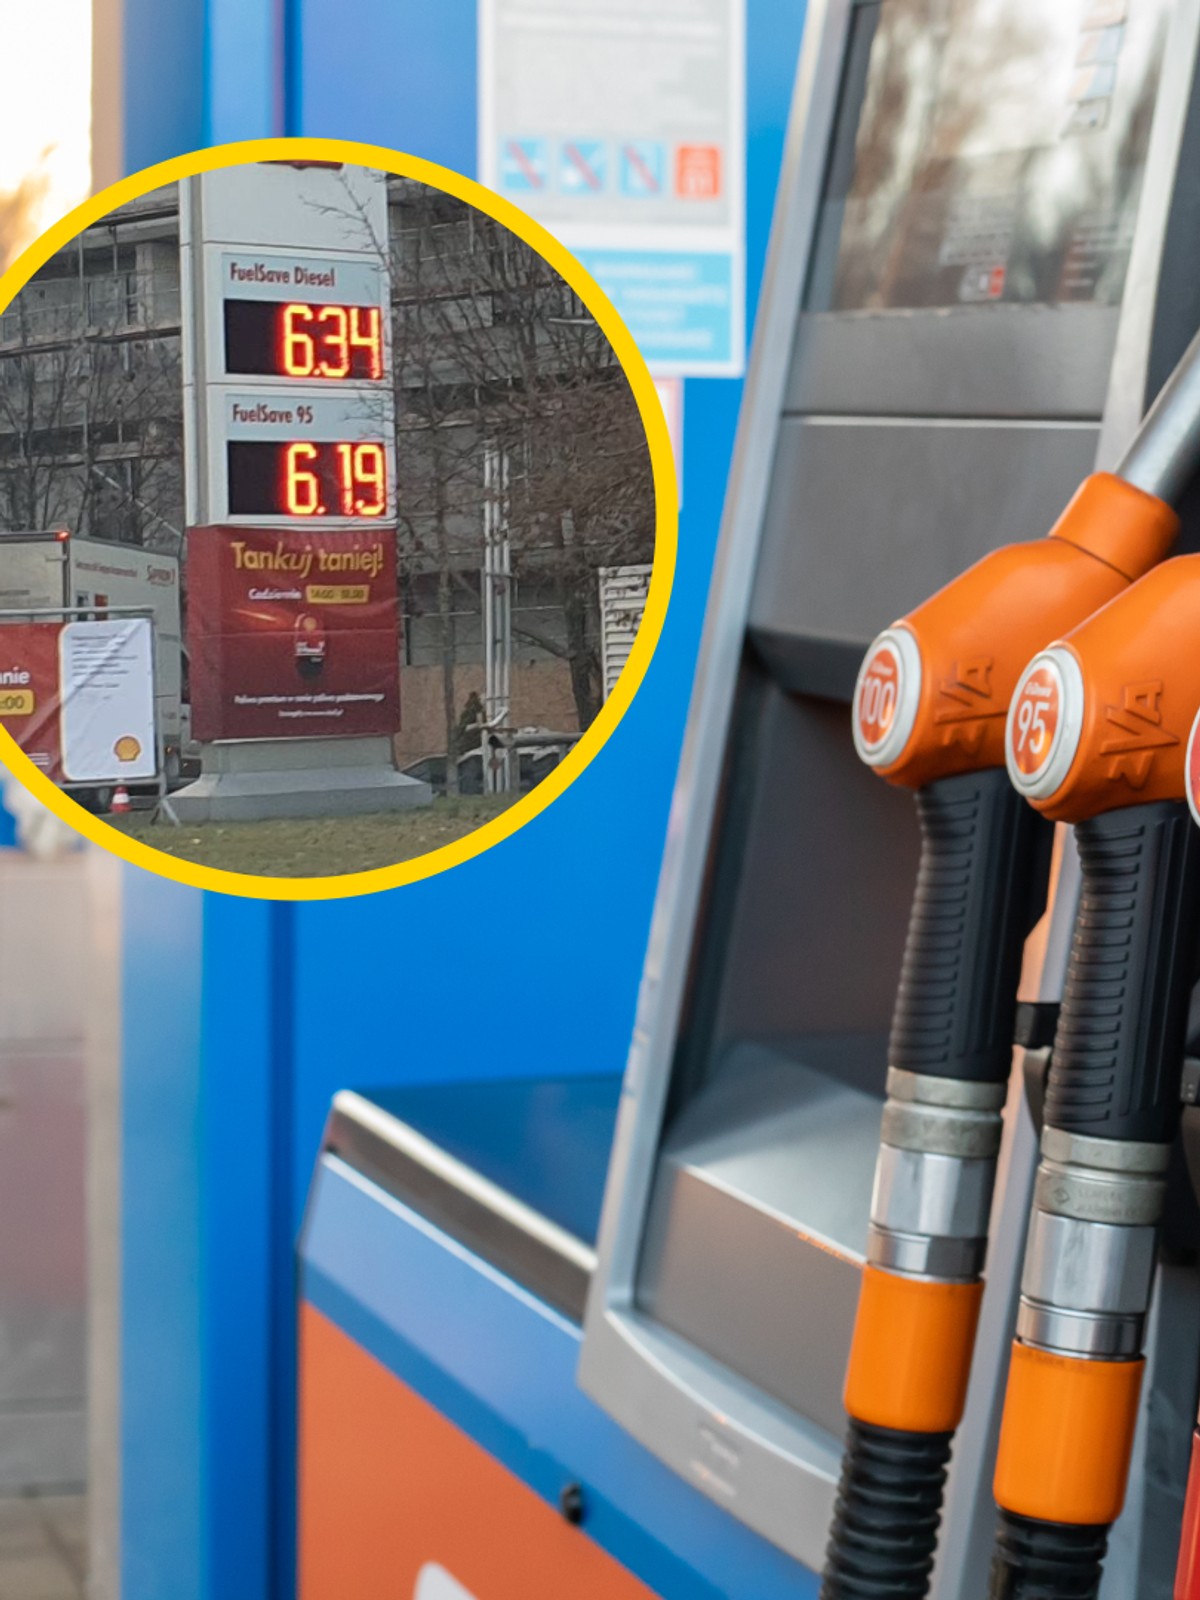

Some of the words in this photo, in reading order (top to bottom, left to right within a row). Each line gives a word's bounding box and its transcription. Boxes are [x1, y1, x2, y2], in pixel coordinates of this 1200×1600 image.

[230, 262, 290, 284] FuelSave
[294, 266, 336, 287] Diesel
[283, 303, 382, 379] 6.34
[232, 403, 294, 424] FuelSave
[296, 405, 314, 424] 95
[286, 442, 385, 516] 6.19
[229, 541, 314, 579] Tankuj
[317, 542, 384, 578] taniej!
[0, 665, 31, 685] nie
[859, 676, 896, 729] 100
[1017, 699, 1051, 755] 95
